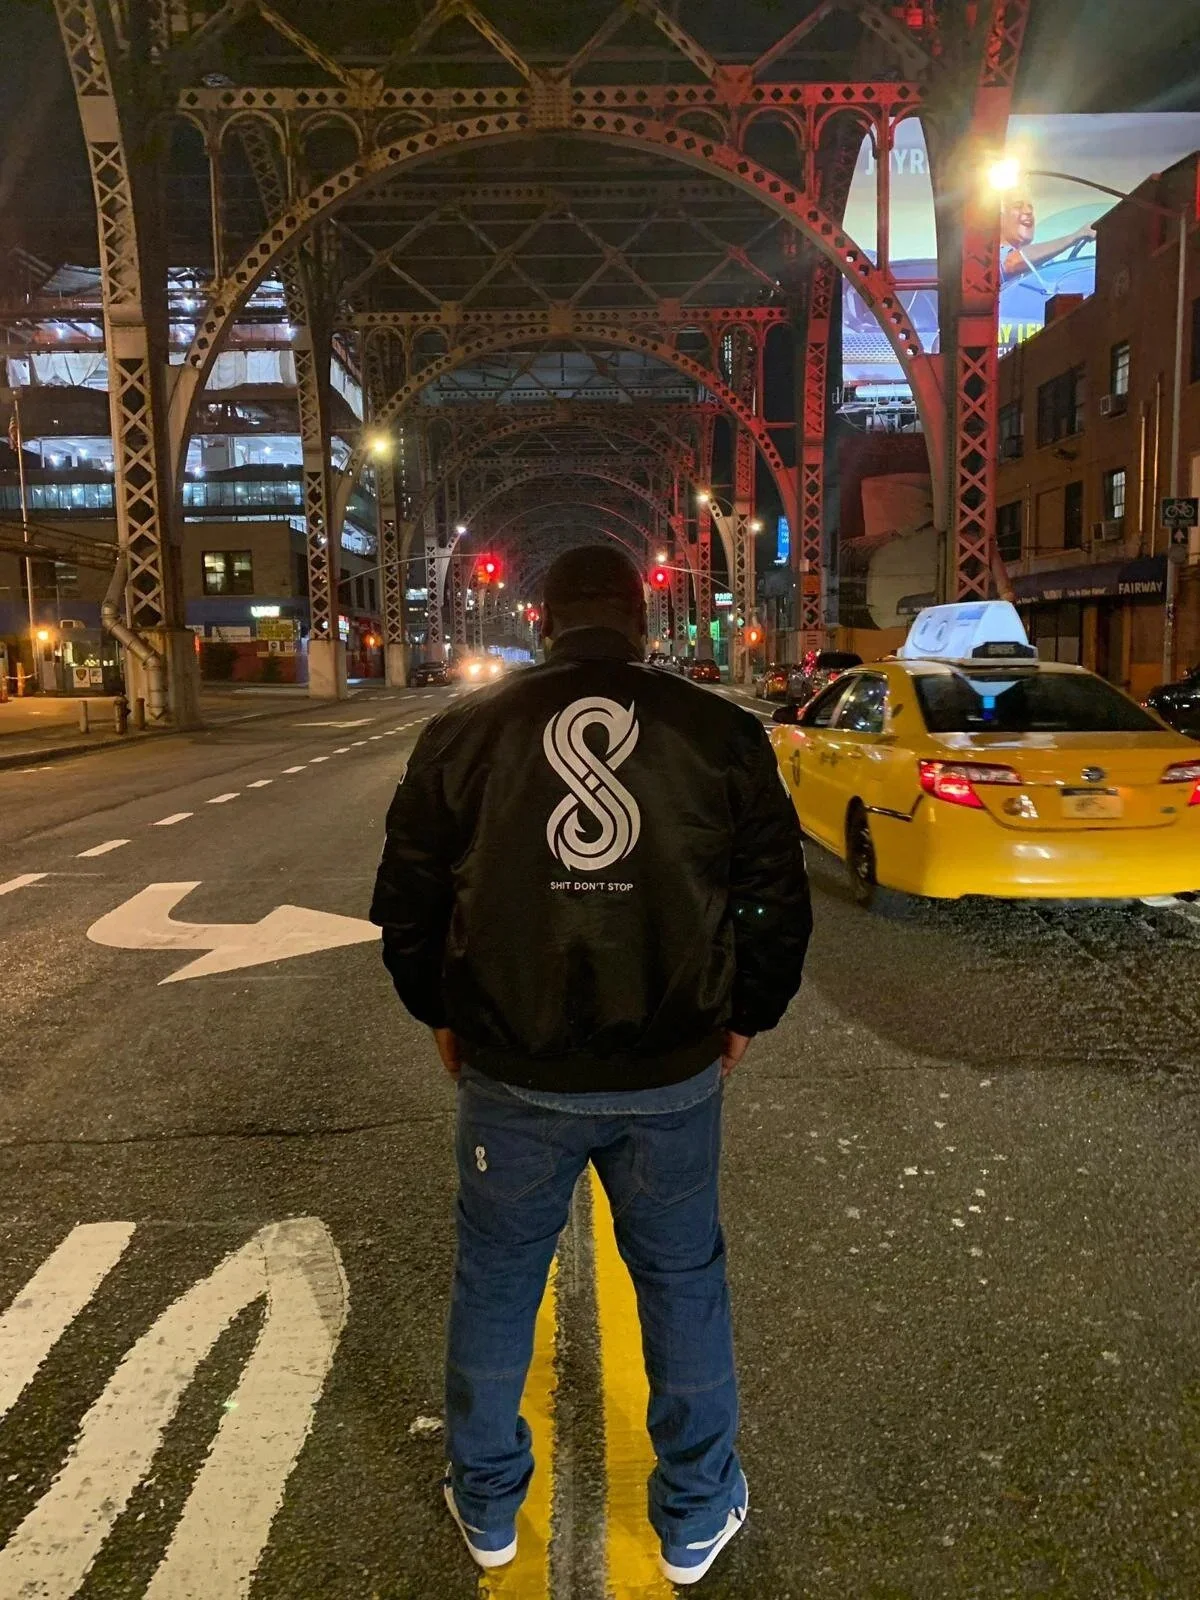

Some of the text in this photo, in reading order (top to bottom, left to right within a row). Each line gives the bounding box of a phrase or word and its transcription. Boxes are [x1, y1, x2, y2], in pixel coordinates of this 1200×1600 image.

[1118, 581, 1163, 594] FAIRWAY
[550, 881, 634, 891] SHIT DON'T STOP
